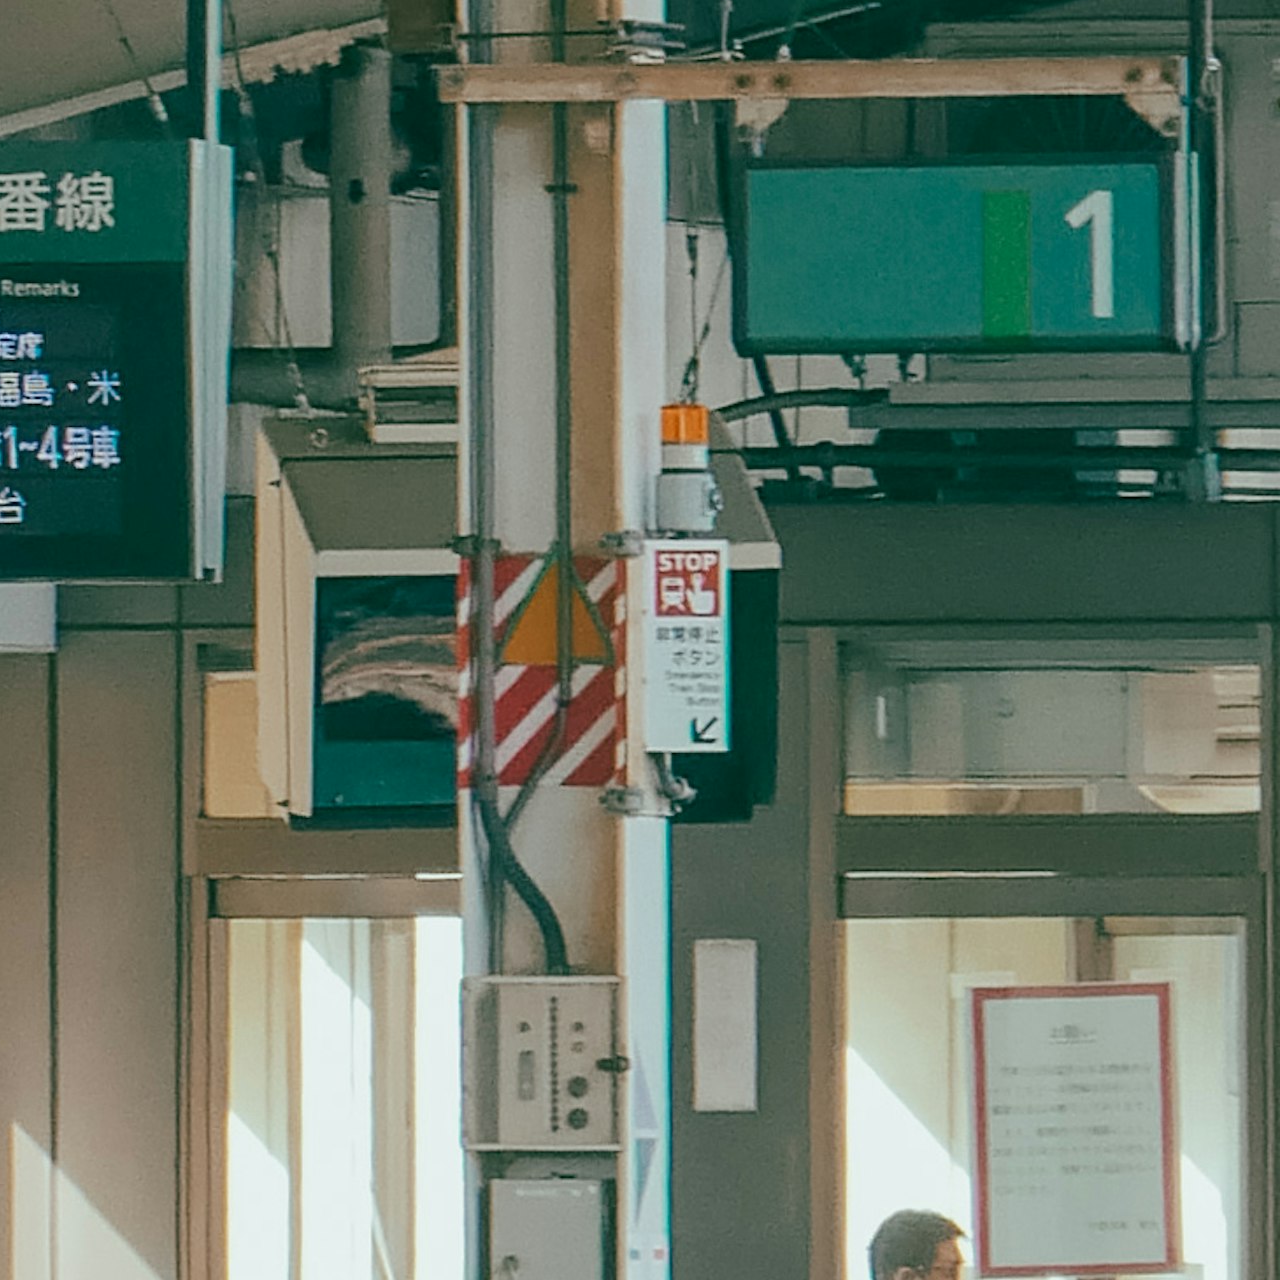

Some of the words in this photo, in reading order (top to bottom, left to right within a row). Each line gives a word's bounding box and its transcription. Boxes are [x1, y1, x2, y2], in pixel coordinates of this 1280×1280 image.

[1063, 189, 1114, 318] 1
[0, 278, 81, 298] Remarks
[657, 553, 719, 573] STOP
